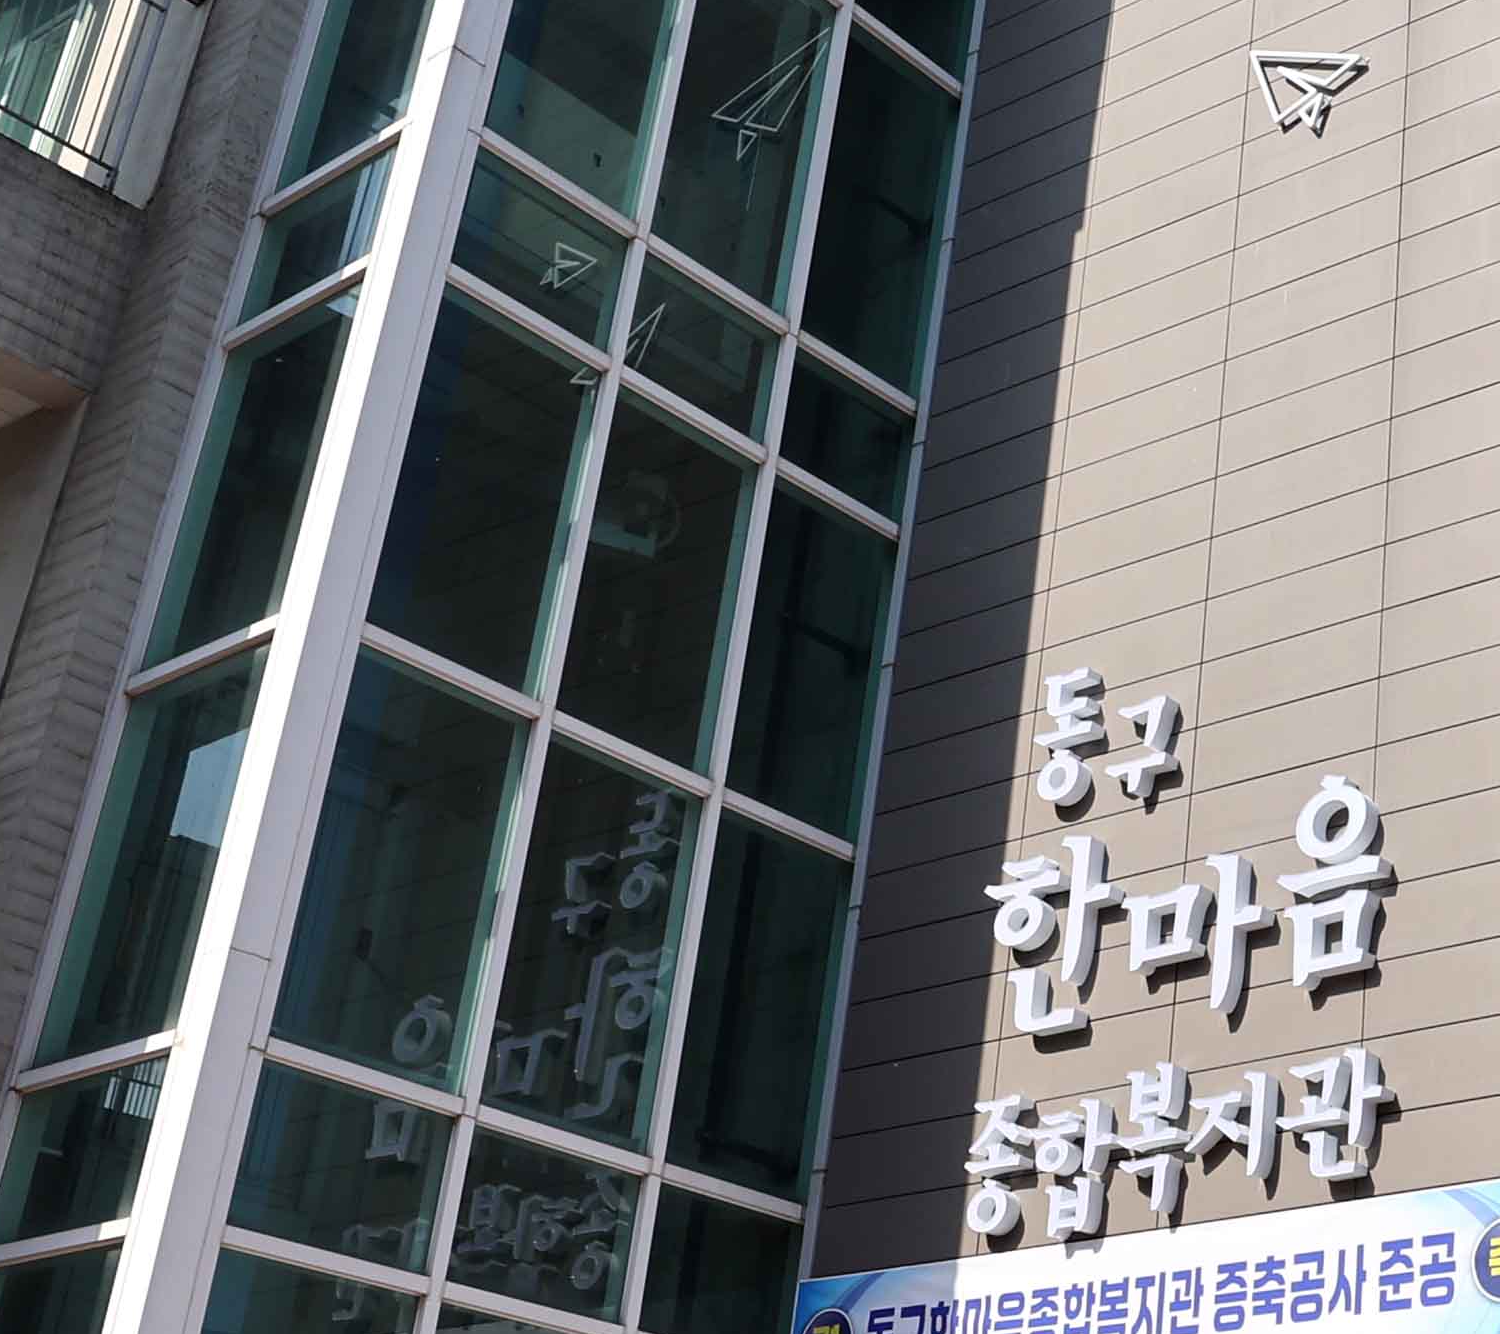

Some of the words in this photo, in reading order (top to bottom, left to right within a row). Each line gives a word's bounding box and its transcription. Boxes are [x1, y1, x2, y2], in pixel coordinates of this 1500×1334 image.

[1033, 666, 1181, 808] 동구
[983, 774, 1395, 1037] 한마음
[964, 1046, 1395, 1242] 종합복지관
[1212, 1242, 1367, 1332] 증축공사
[1377, 1232, 1457, 1306] 준공
